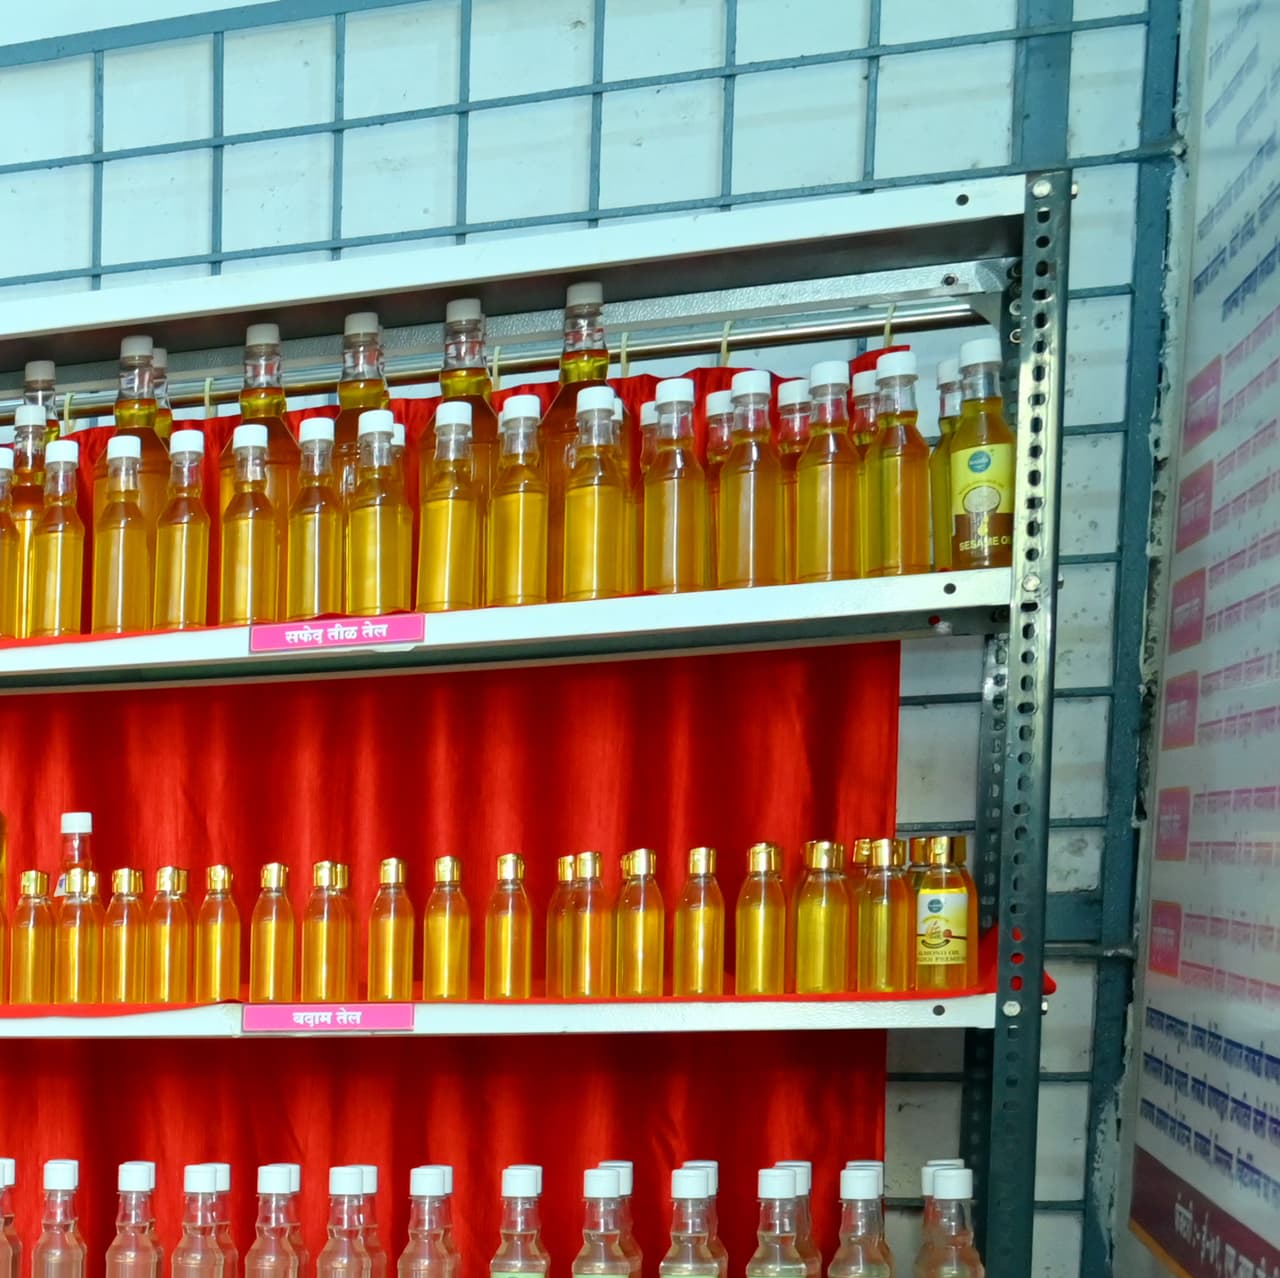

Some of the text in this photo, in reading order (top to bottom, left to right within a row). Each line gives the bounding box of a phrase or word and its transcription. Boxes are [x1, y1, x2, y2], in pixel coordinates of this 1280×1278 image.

[285, 620, 388, 644] सफेद तीळ तेल
[292, 1007, 362, 1028] बदाम तेल
